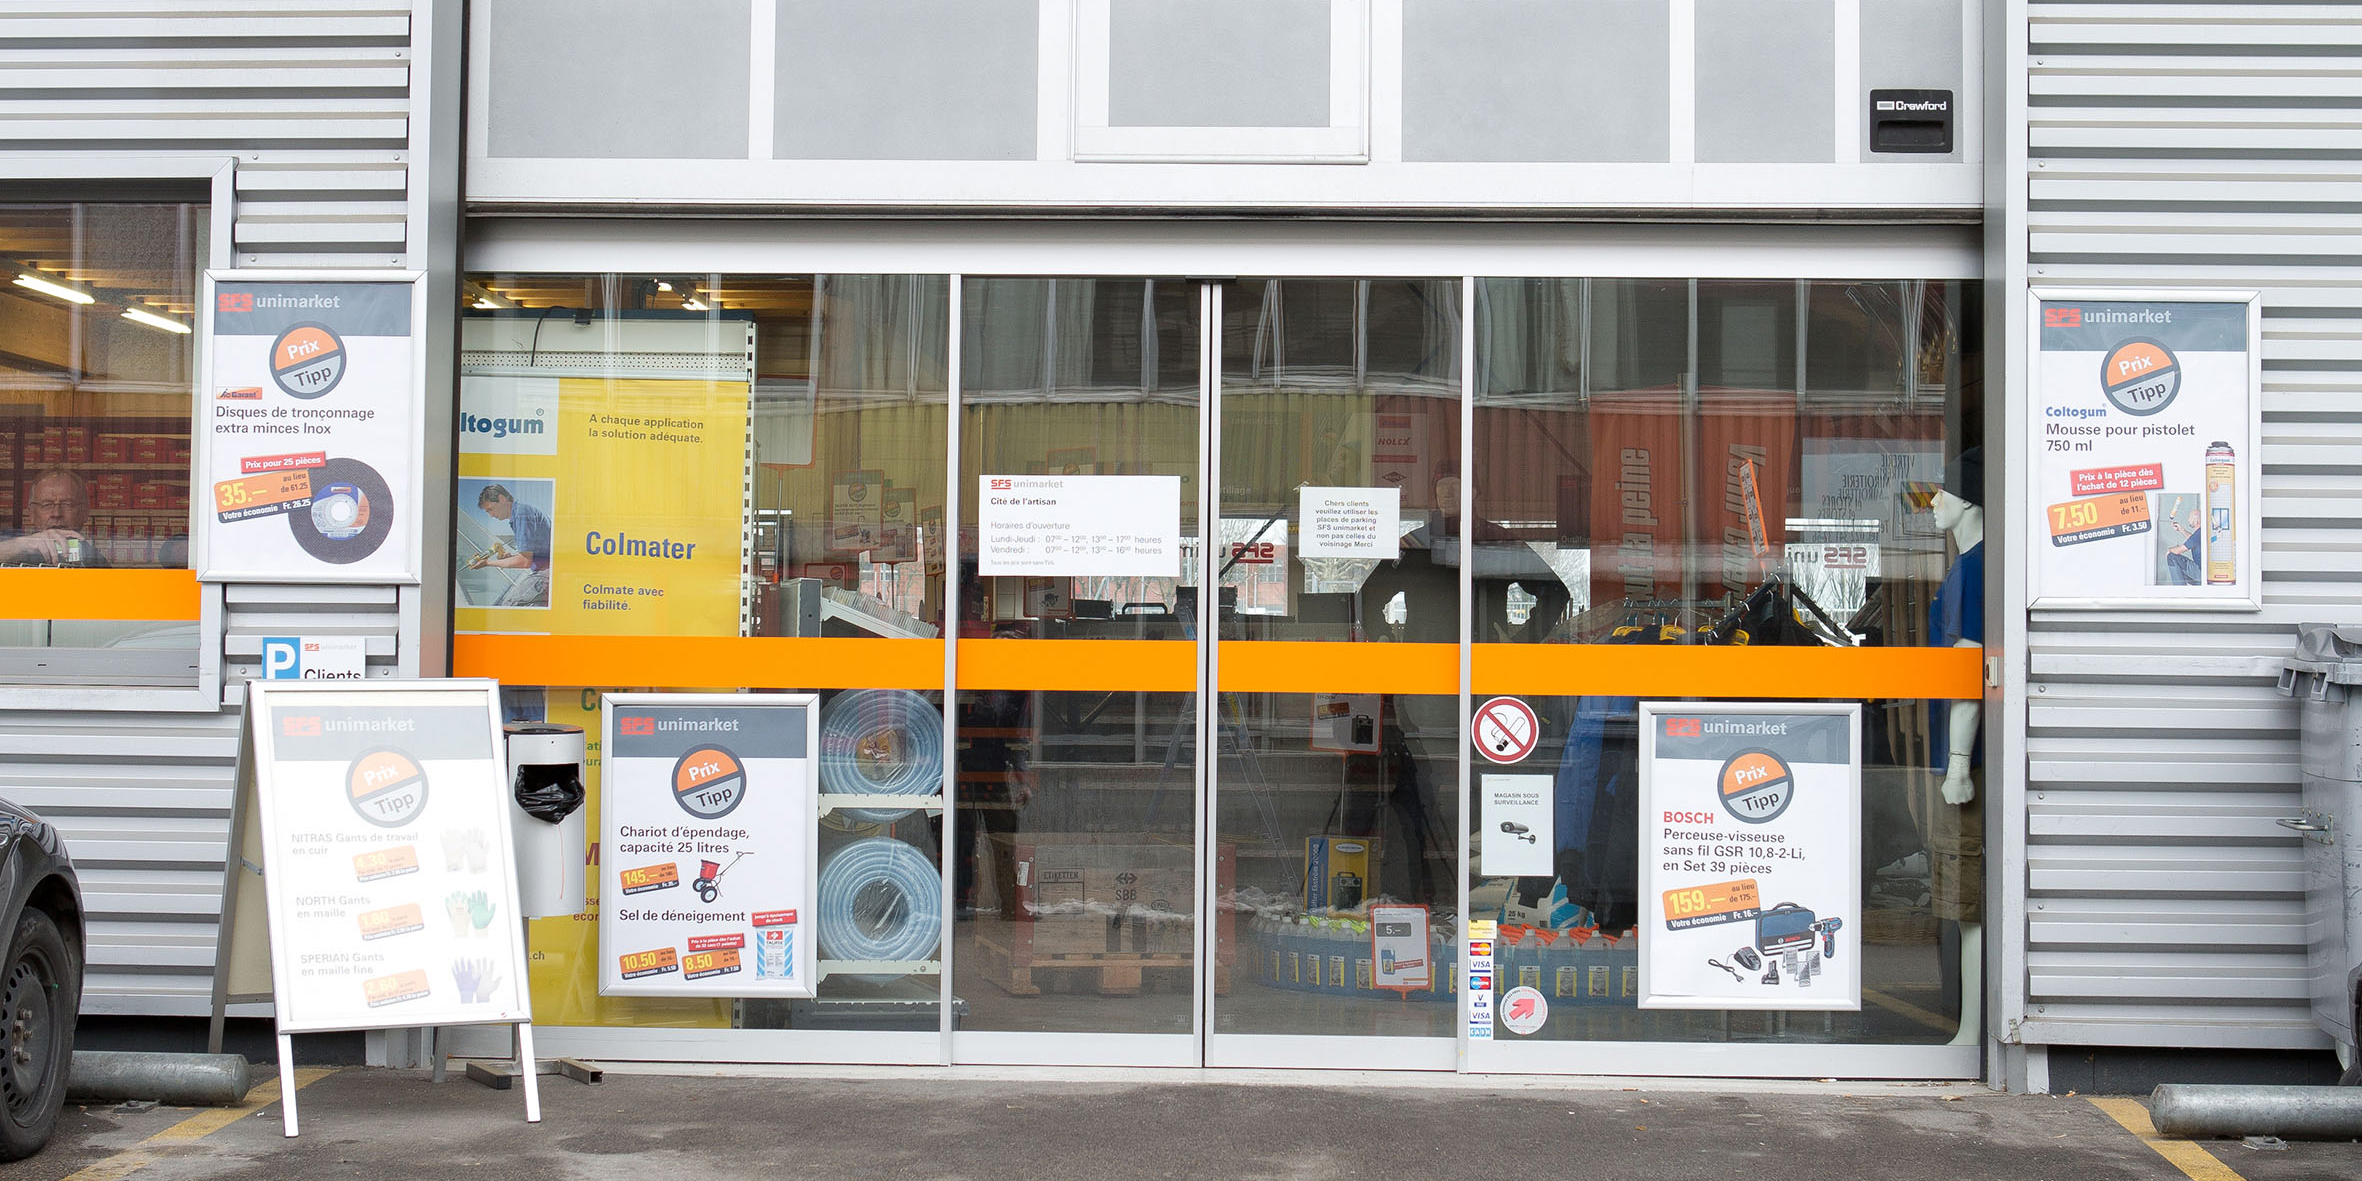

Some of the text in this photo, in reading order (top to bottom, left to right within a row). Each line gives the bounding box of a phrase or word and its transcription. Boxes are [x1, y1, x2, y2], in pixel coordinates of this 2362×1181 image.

[1896, 101, 1946, 110] Crawford
[218, 293, 340, 310] SFS unimarket
[2045, 308, 2172, 327] SFS unimarket
[287, 339, 320, 360] Prix
[2119, 354, 2153, 376] Prix
[294, 364, 332, 388] Tipp
[2127, 382, 2166, 404] Tipp
[216, 406, 374, 421] Disques de tronçonnage
[2046, 406, 2106, 419] Coltogum
[216, 422, 332, 434] extra minces Inox
[589, 414, 704, 430] A chaque application
[588, 428, 704, 444] la solution adéquate.
[2046, 423, 2195, 438] Mousse pour pistolet
[2046, 440, 2093, 452] 750 ml
[246, 461, 262, 469] Prix
[263, 460, 282, 469] pour
[296, 456, 321, 466] pièces
[2079, 468, 2154, 482] Prix la pièce dès
[991, 480, 1063, 489] SFS unimarket
[1614, 448, 1659, 526] peine
[2131, 478, 2158, 488] pièces
[991, 498, 1008, 506] Cité
[1022, 498, 1056, 506] l'artisan
[2120, 494, 2144, 504] au lieu
[2053, 502, 2098, 530] 7.50
[991, 522, 1070, 530] Horaires d'ouverture
[2057, 522, 2148, 544] Votre économie 3.50
[586, 531, 696, 560] Colmater
[991, 536, 1162, 544] Lundi-Jeudi heures
[991, 546, 1162, 554] Vendredi heures
[583, 584, 664, 598] Colmate avec
[583, 598, 632, 612] fiabilité.
[283, 716, 416, 736] SFS unimarket
[620, 718, 738, 735] SFS unimarket
[1666, 718, 1787, 736] SFS unimarket
[363, 764, 398, 786] Prix
[688, 761, 720, 782] Prix
[1735, 764, 1768, 786] Prix
[374, 791, 414, 816] Tipp
[696, 788, 732, 808] Tipp
[1742, 791, 1780, 812] Tipp
[1664, 811, 1714, 824] BOSCH
[292, 832, 418, 843] NITRAS Gants de travail
[620, 826, 750, 840] Chariot d'épendage,
[1664, 828, 1784, 843] Perceuse-visseuse
[308, 846, 328, 854] cuir
[620, 842, 730, 854] capacité 25 litres
[1664, 845, 1806, 861] sans fil GSR 10,8-2-Li,
[1663, 860, 1772, 875] en Set 39 pièces
[296, 896, 371, 906] NORTH Gants
[1116, 889, 1137, 900] SBB
[314, 908, 346, 918] maille
[619, 910, 640, 922] Sel
[642, 910, 658, 922] de
[661, 910, 746, 924] déneigement
[1518, 910, 1526, 918] kg
[300, 952, 384, 964] SPERIAN Gants
[623, 952, 656, 970] 10.50
[685, 954, 712, 970] 8.50
[318, 965, 374, 975] maille fine
